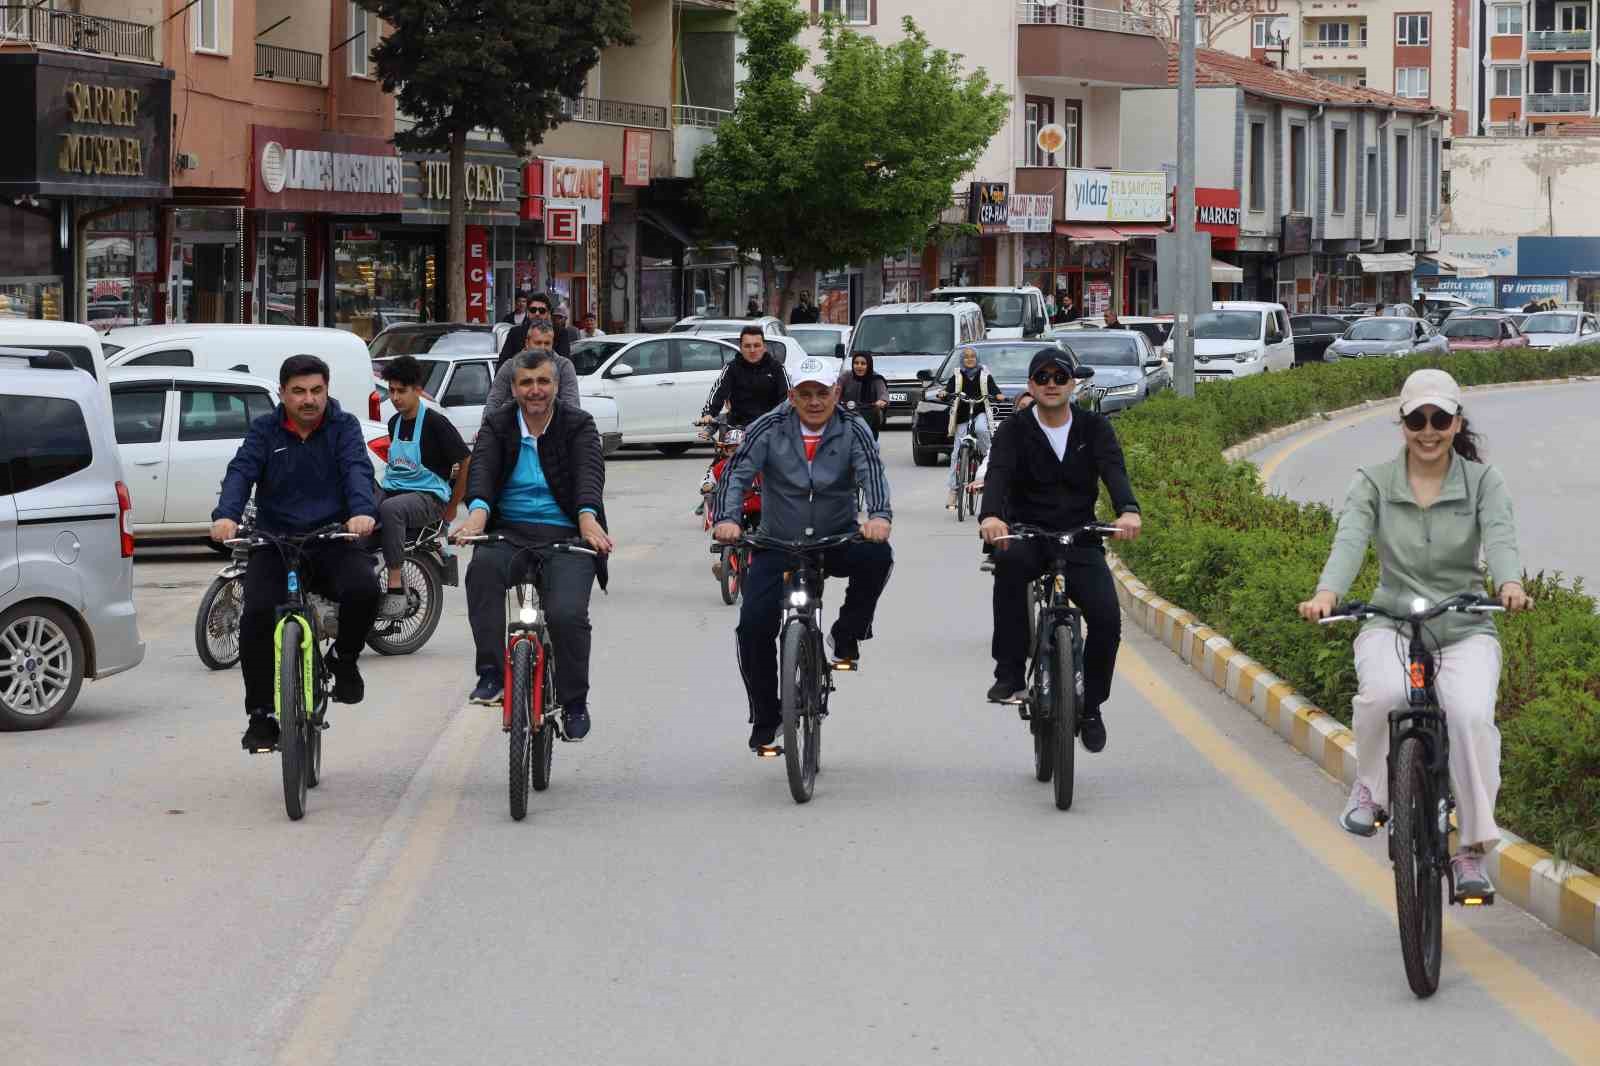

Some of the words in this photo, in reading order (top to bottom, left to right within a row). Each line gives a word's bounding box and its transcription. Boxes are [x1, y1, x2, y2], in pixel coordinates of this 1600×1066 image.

[71, 81, 140, 127] SARRAF
[60, 133, 144, 176] MUSTAFA
[552, 166, 602, 200] ECZANE
[1075, 178, 1108, 211] yıldız
[555, 213, 574, 236] E
[1200, 206, 1241, 225] MARKET
[1502, 283, 1514, 293] EV
